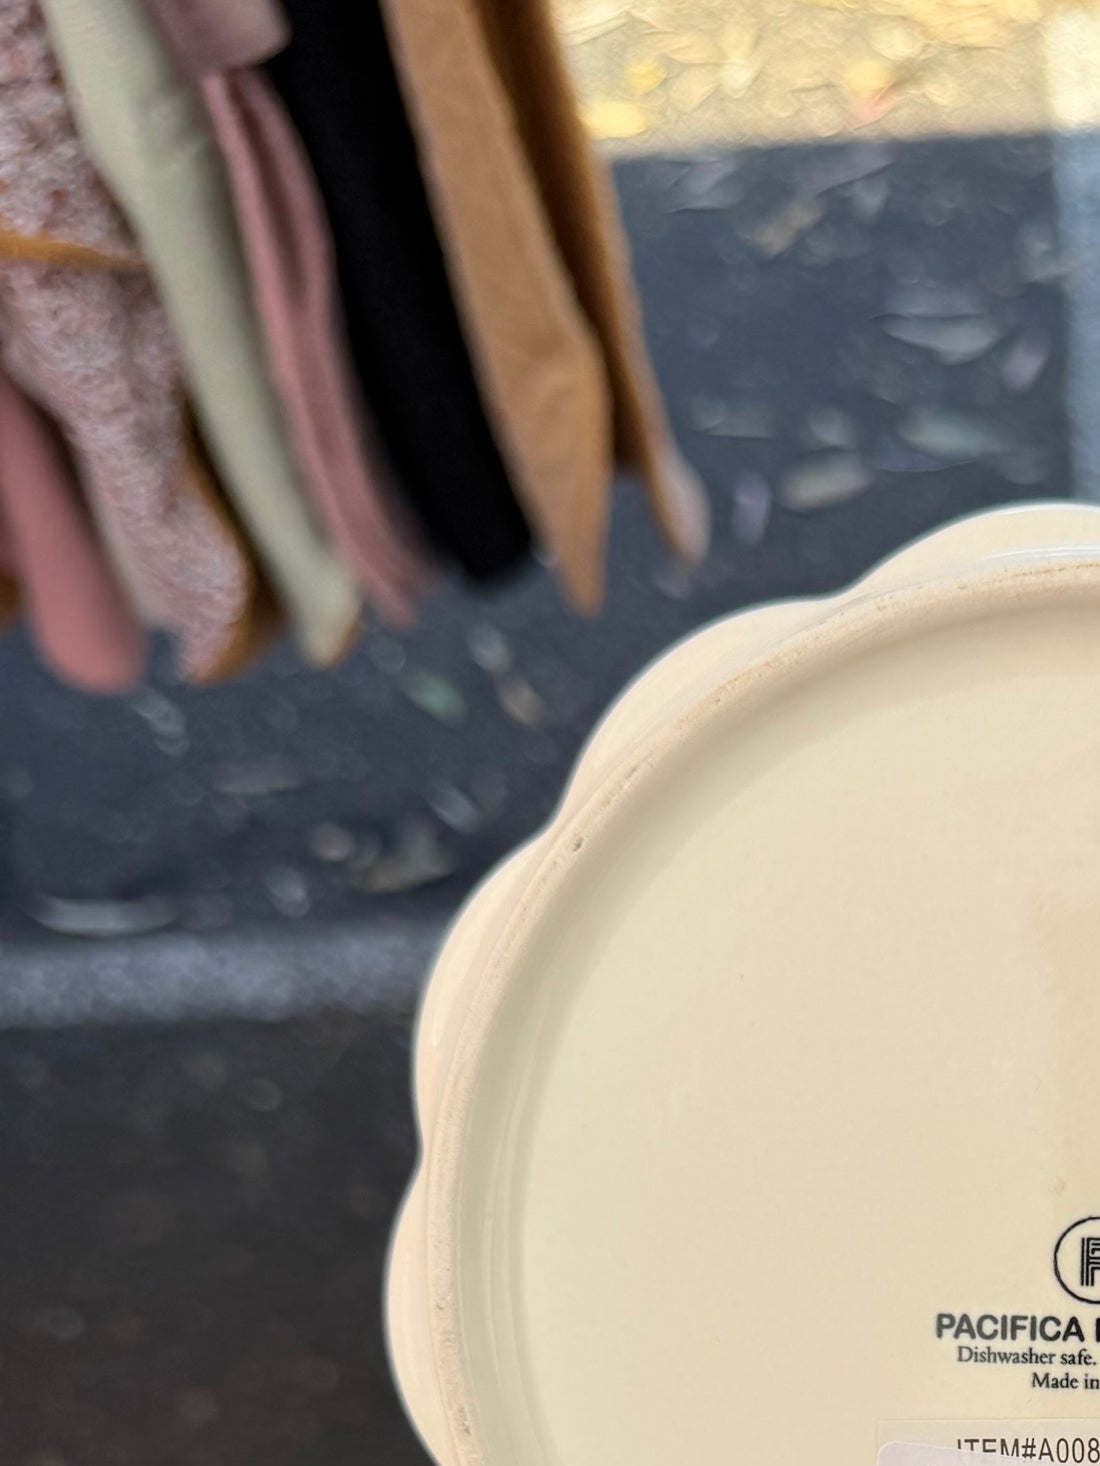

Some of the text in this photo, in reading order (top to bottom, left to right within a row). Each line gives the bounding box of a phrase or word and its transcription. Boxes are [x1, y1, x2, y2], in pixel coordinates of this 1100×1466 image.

[936, 1313, 1085, 1343] PACIFICA
[956, 1345, 1055, 1366] Dishwasher
[1060, 1350, 1097, 1367] safe.
[1031, 1372, 1079, 1390] Made
[1084, 1374, 1100, 1390] in
